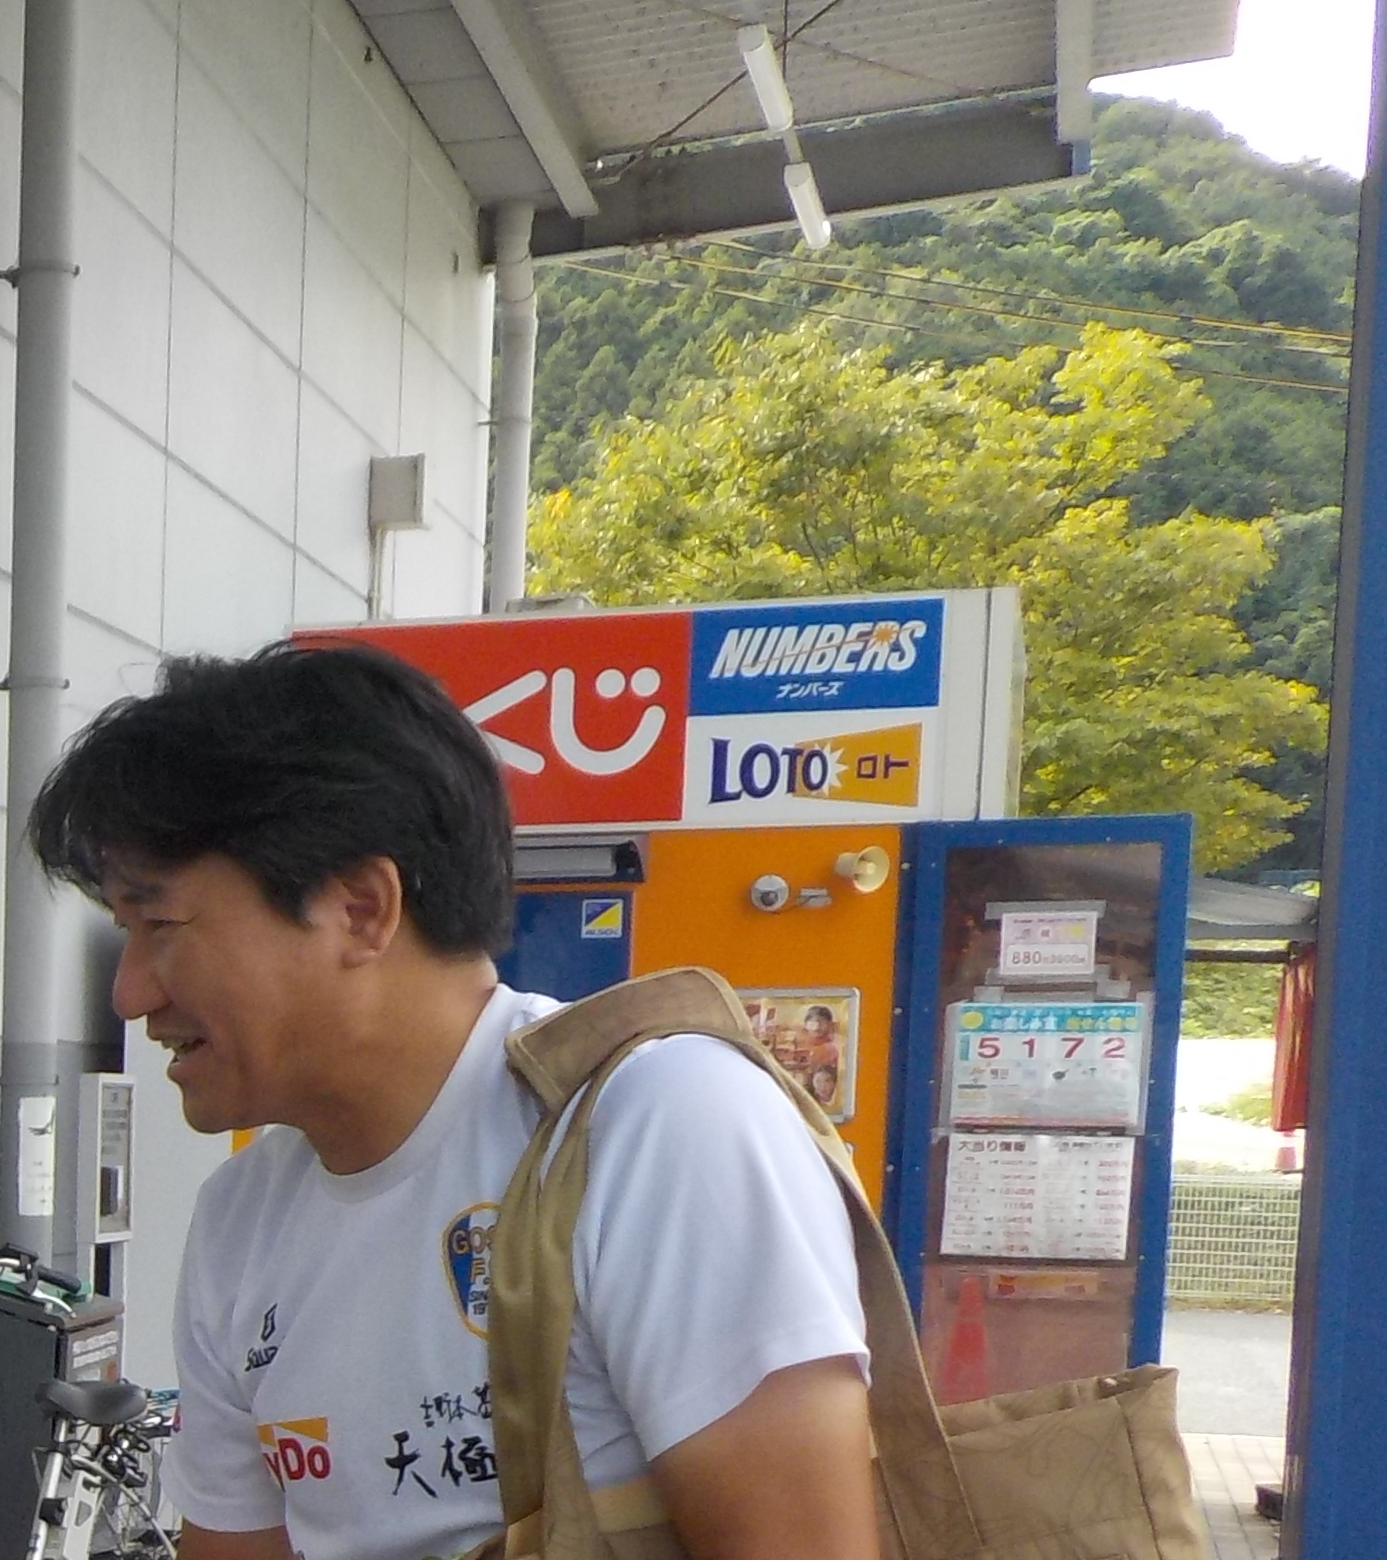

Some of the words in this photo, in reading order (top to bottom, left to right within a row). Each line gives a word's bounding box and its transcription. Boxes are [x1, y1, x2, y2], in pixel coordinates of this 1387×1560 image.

[709, 621, 928, 679] NUMBERS
[776, 681, 845, 699] ナンバーズ
[463, 667, 667, 776] くじ
[708, 737, 829, 804] LOTO
[856, 754, 909, 779] ロト
[977, 1037, 1001, 1059] 5
[1022, 1037, 1037, 1059] 1
[1061, 1037, 1085, 1059] 7
[1101, 1037, 1126, 1059] 2
